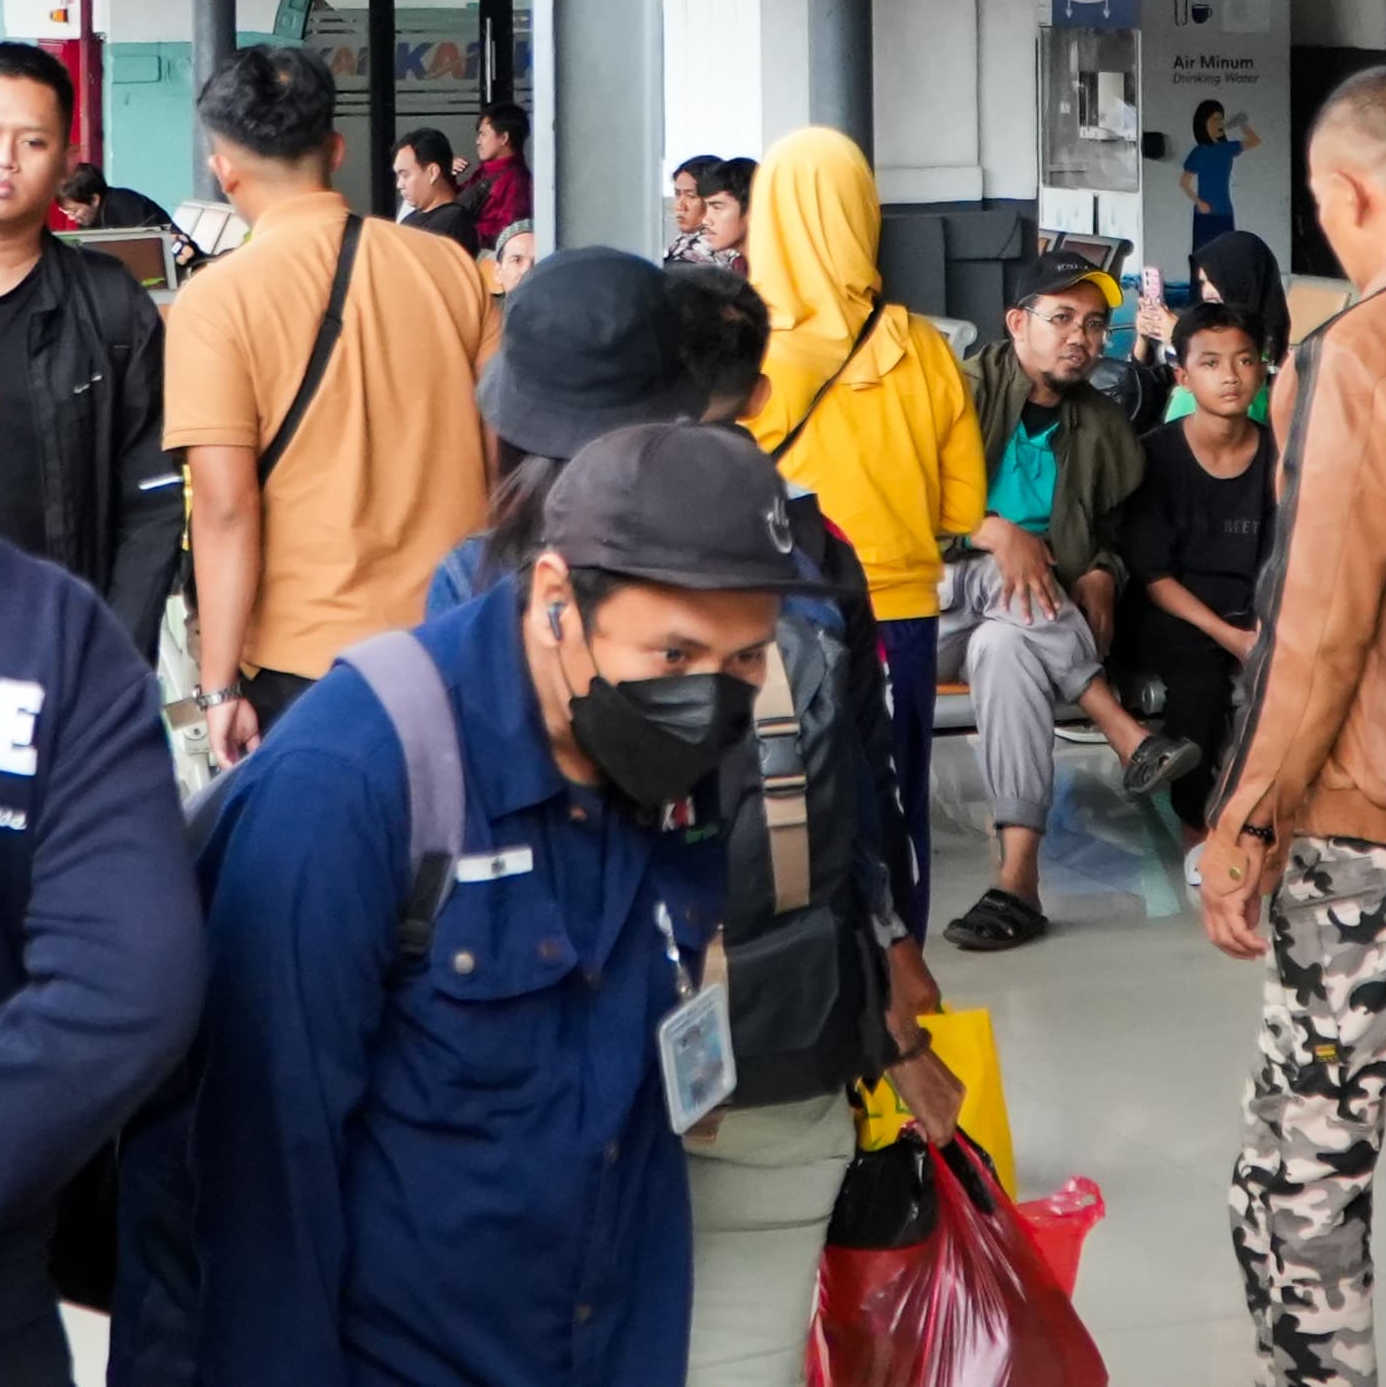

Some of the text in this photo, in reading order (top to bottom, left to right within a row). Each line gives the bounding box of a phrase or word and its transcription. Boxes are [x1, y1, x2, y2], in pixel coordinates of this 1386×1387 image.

[1173, 54, 1254, 70] Air Minum
[1224, 72, 1260, 84] Water
